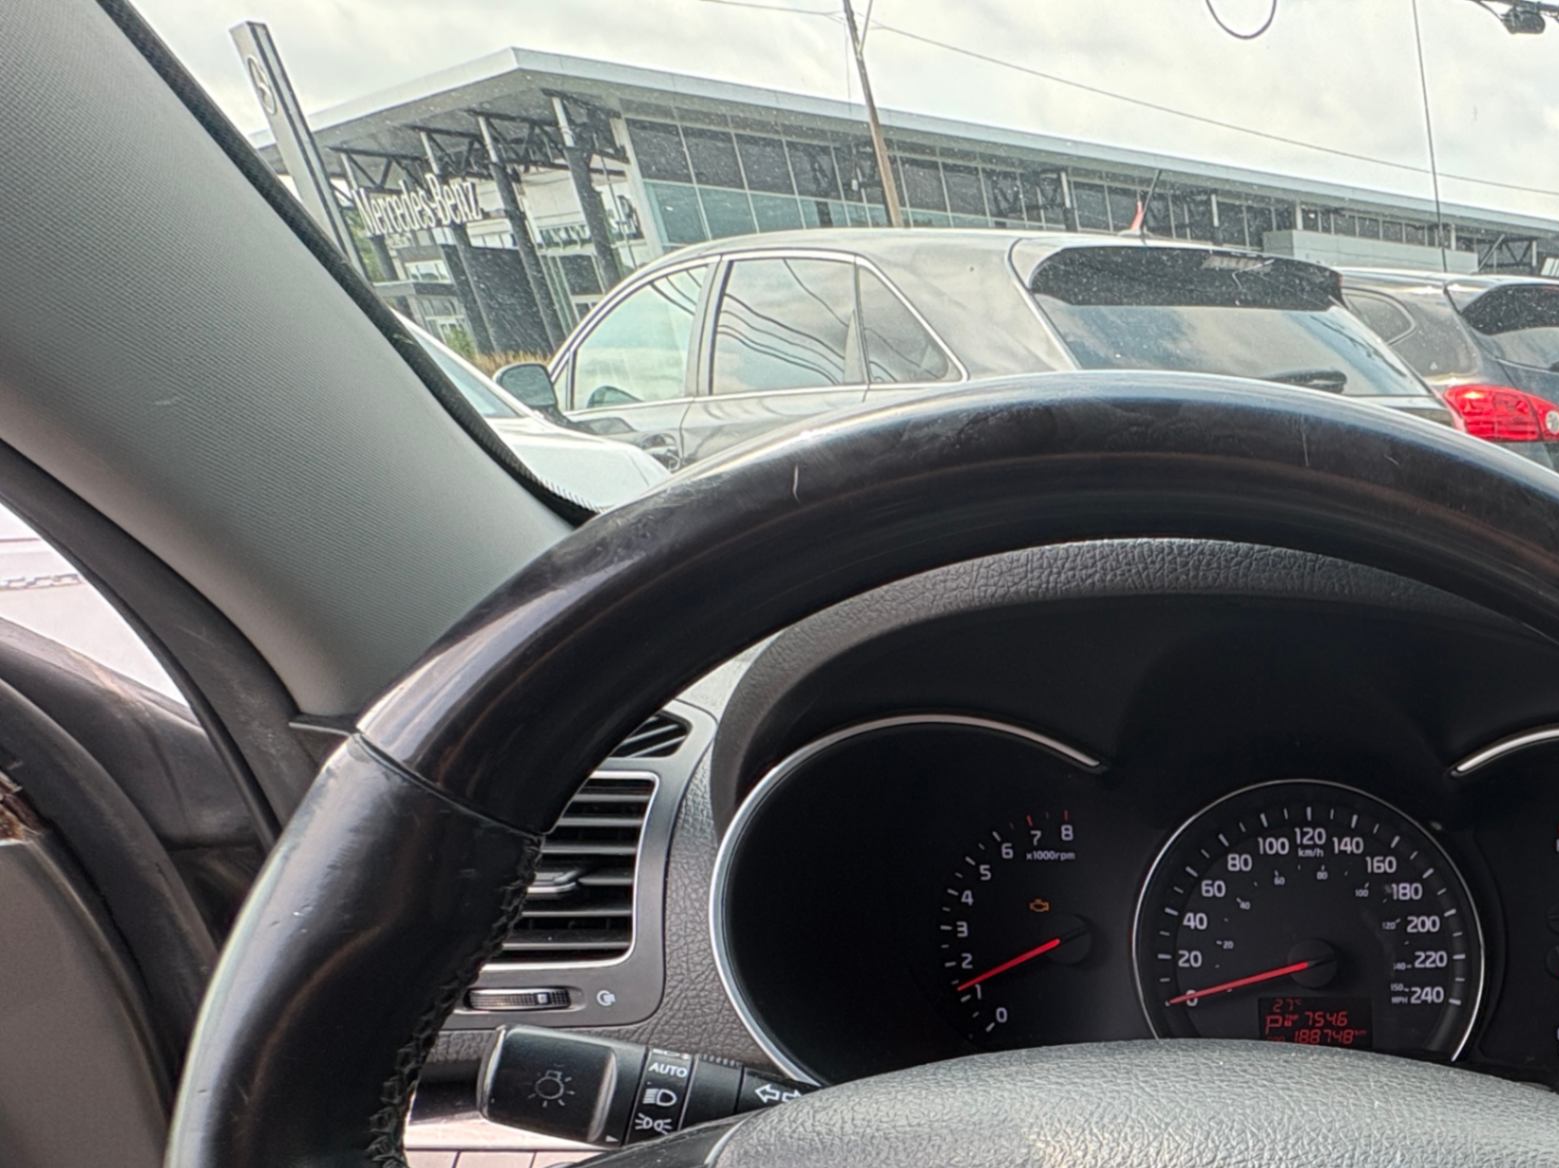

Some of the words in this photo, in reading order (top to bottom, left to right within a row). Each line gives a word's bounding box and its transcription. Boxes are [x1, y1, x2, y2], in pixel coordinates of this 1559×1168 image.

[352, 173, 483, 237] Mercedes-Benz
[1030, 831, 1042, 846] 7
[1061, 825, 1073, 841] 8
[1294, 828, 1326, 845] 120
[1002, 843, 1013, 859] 6
[1258, 838, 1289, 855] 100
[1298, 847, 1324, 858] km/h
[1332, 837, 1364, 854] 140
[1227, 854, 1252, 871] 80
[1366, 856, 1397, 873] 160
[980, 865, 991, 880] 5
[1201, 880, 1225, 897] 60
[1391, 883, 1423, 900] 180
[961, 890, 974, 906] 4
[957, 922, 968, 937] 3
[1183, 913, 1207, 930] 40
[1407, 915, 1440, 933] 200
[961, 953, 973, 968] 2
[1178, 951, 1202, 967] 20
[1414, 951, 1448, 968] 220
[975, 984, 982, 999] 1
[1186, 990, 1198, 1006] 0
[1410, 986, 1445, 1004] 240
[995, 1008, 1008, 1023] 0
[1295, 1029, 1354, 1045] 188748
[649, 1061, 688, 1079] AUTO
